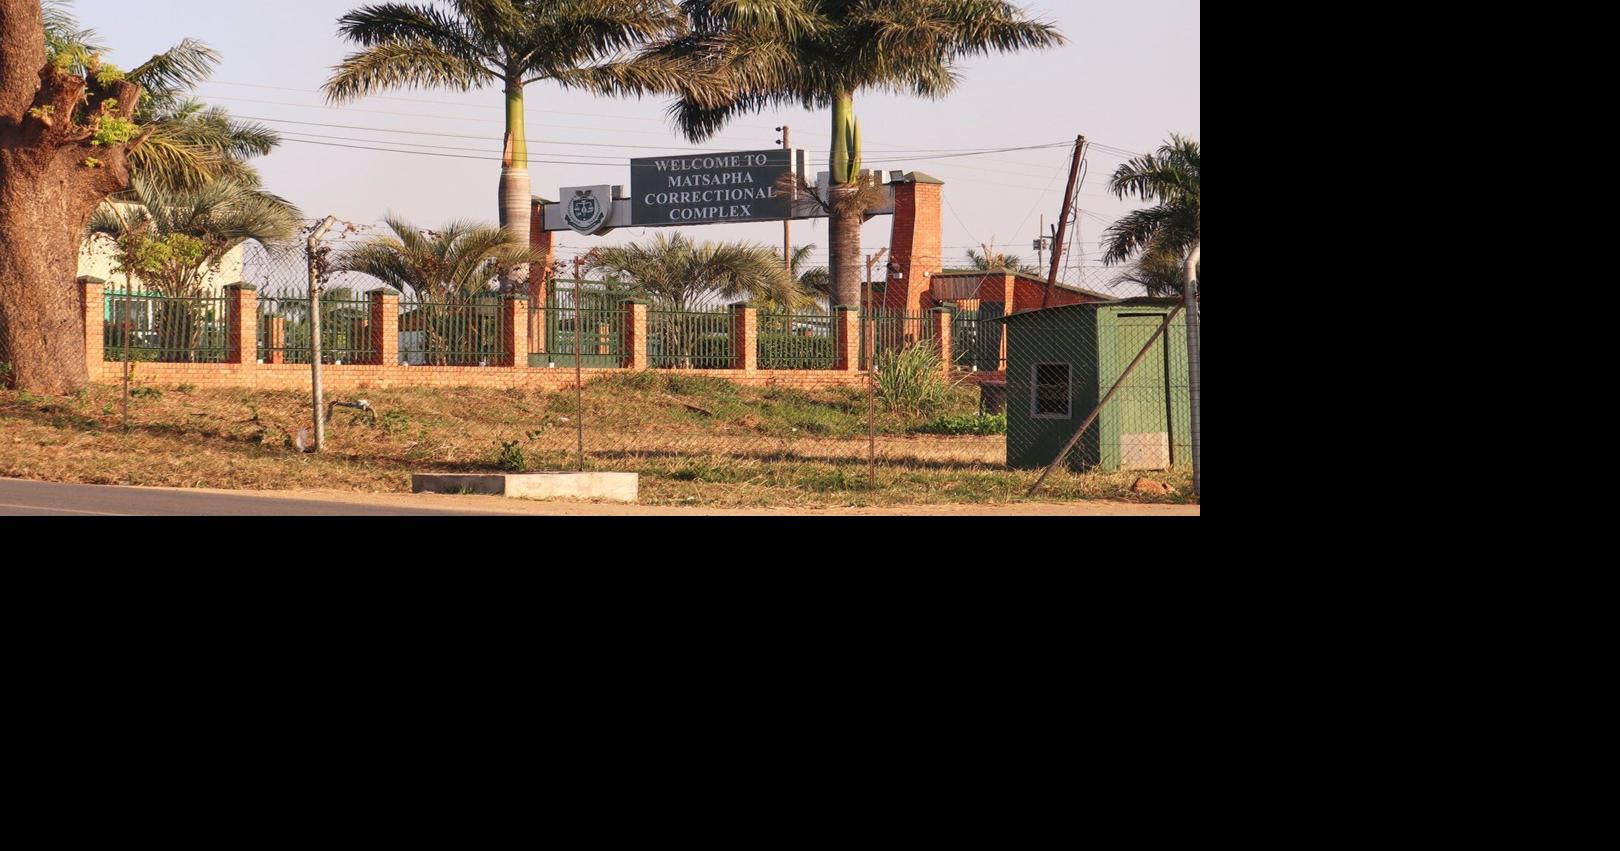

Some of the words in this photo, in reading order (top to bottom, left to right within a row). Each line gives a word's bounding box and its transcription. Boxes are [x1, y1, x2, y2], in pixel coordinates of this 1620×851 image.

[655, 155, 740, 171] WELCOME
[745, 153, 767, 166] TO
[668, 172, 753, 188] MATSAPHA
[644, 186, 776, 205] CORRECTIONAL
[669, 204, 752, 220] COMPLEX
